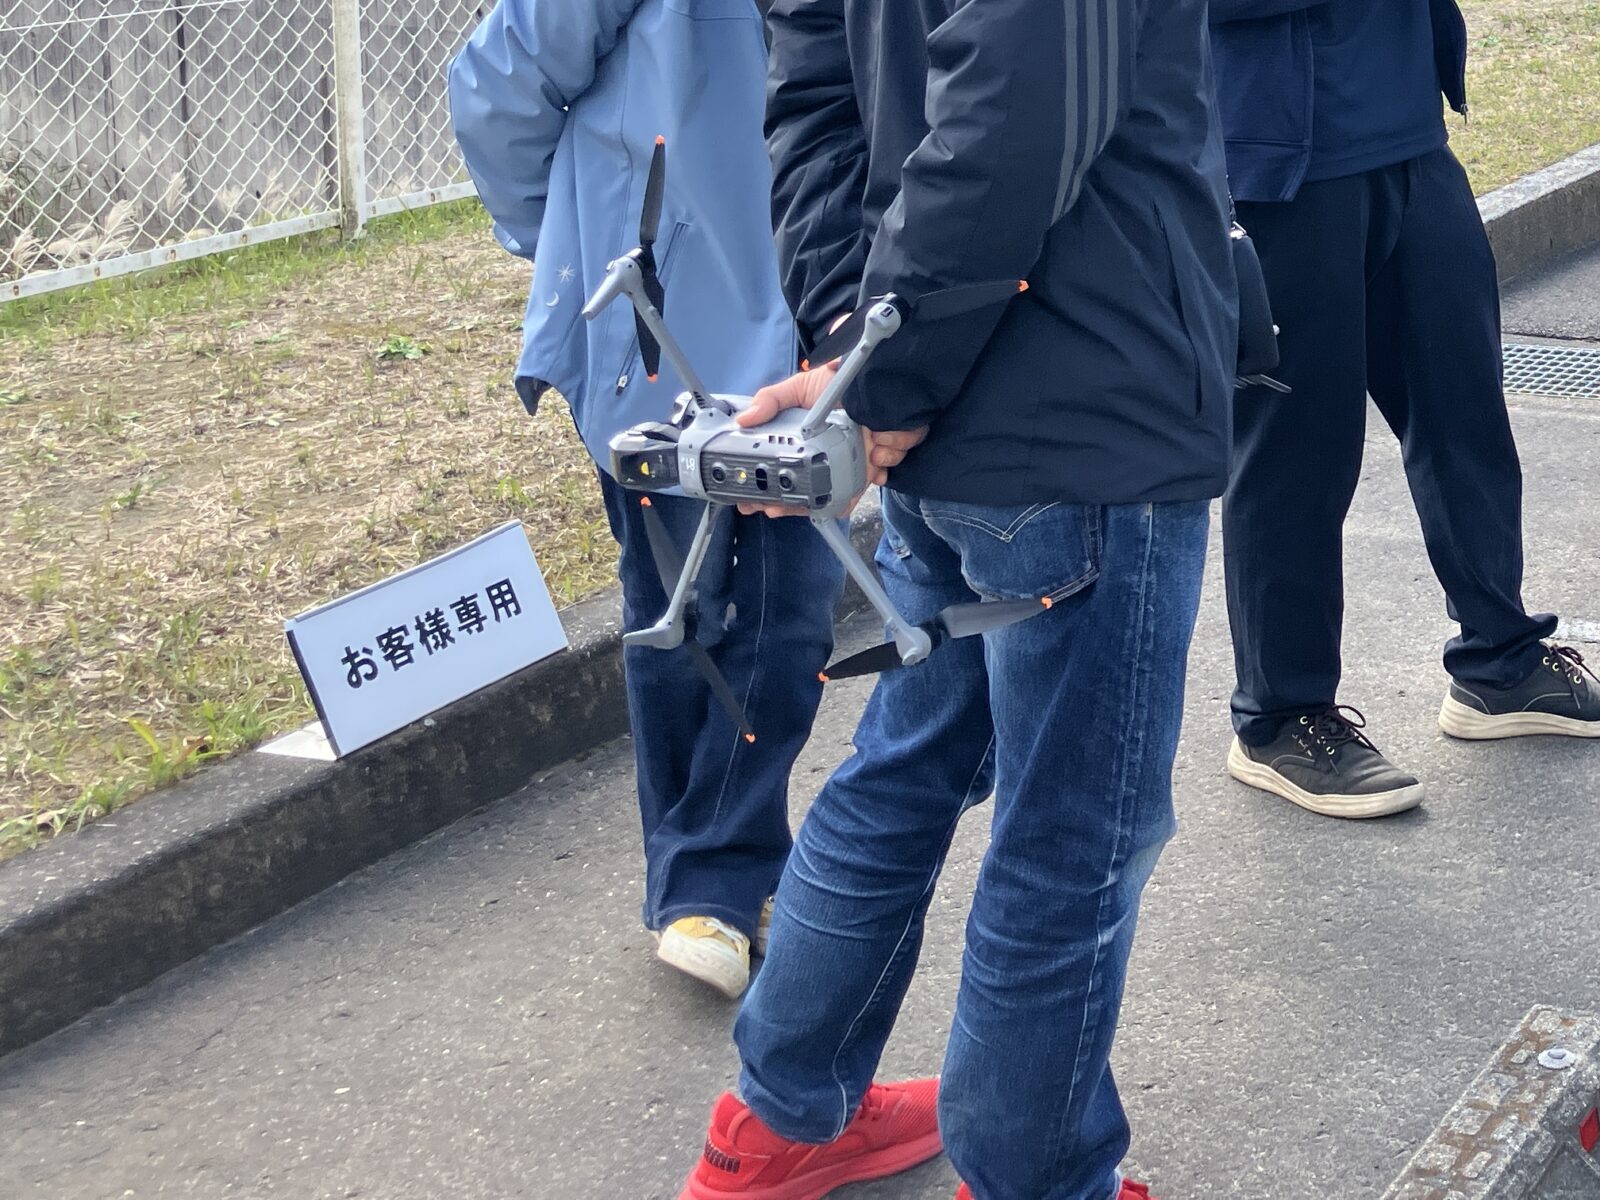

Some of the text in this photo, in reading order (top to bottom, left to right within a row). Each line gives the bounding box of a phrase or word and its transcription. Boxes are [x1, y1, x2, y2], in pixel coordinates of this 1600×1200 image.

[339, 577, 523, 690] お客様専用
